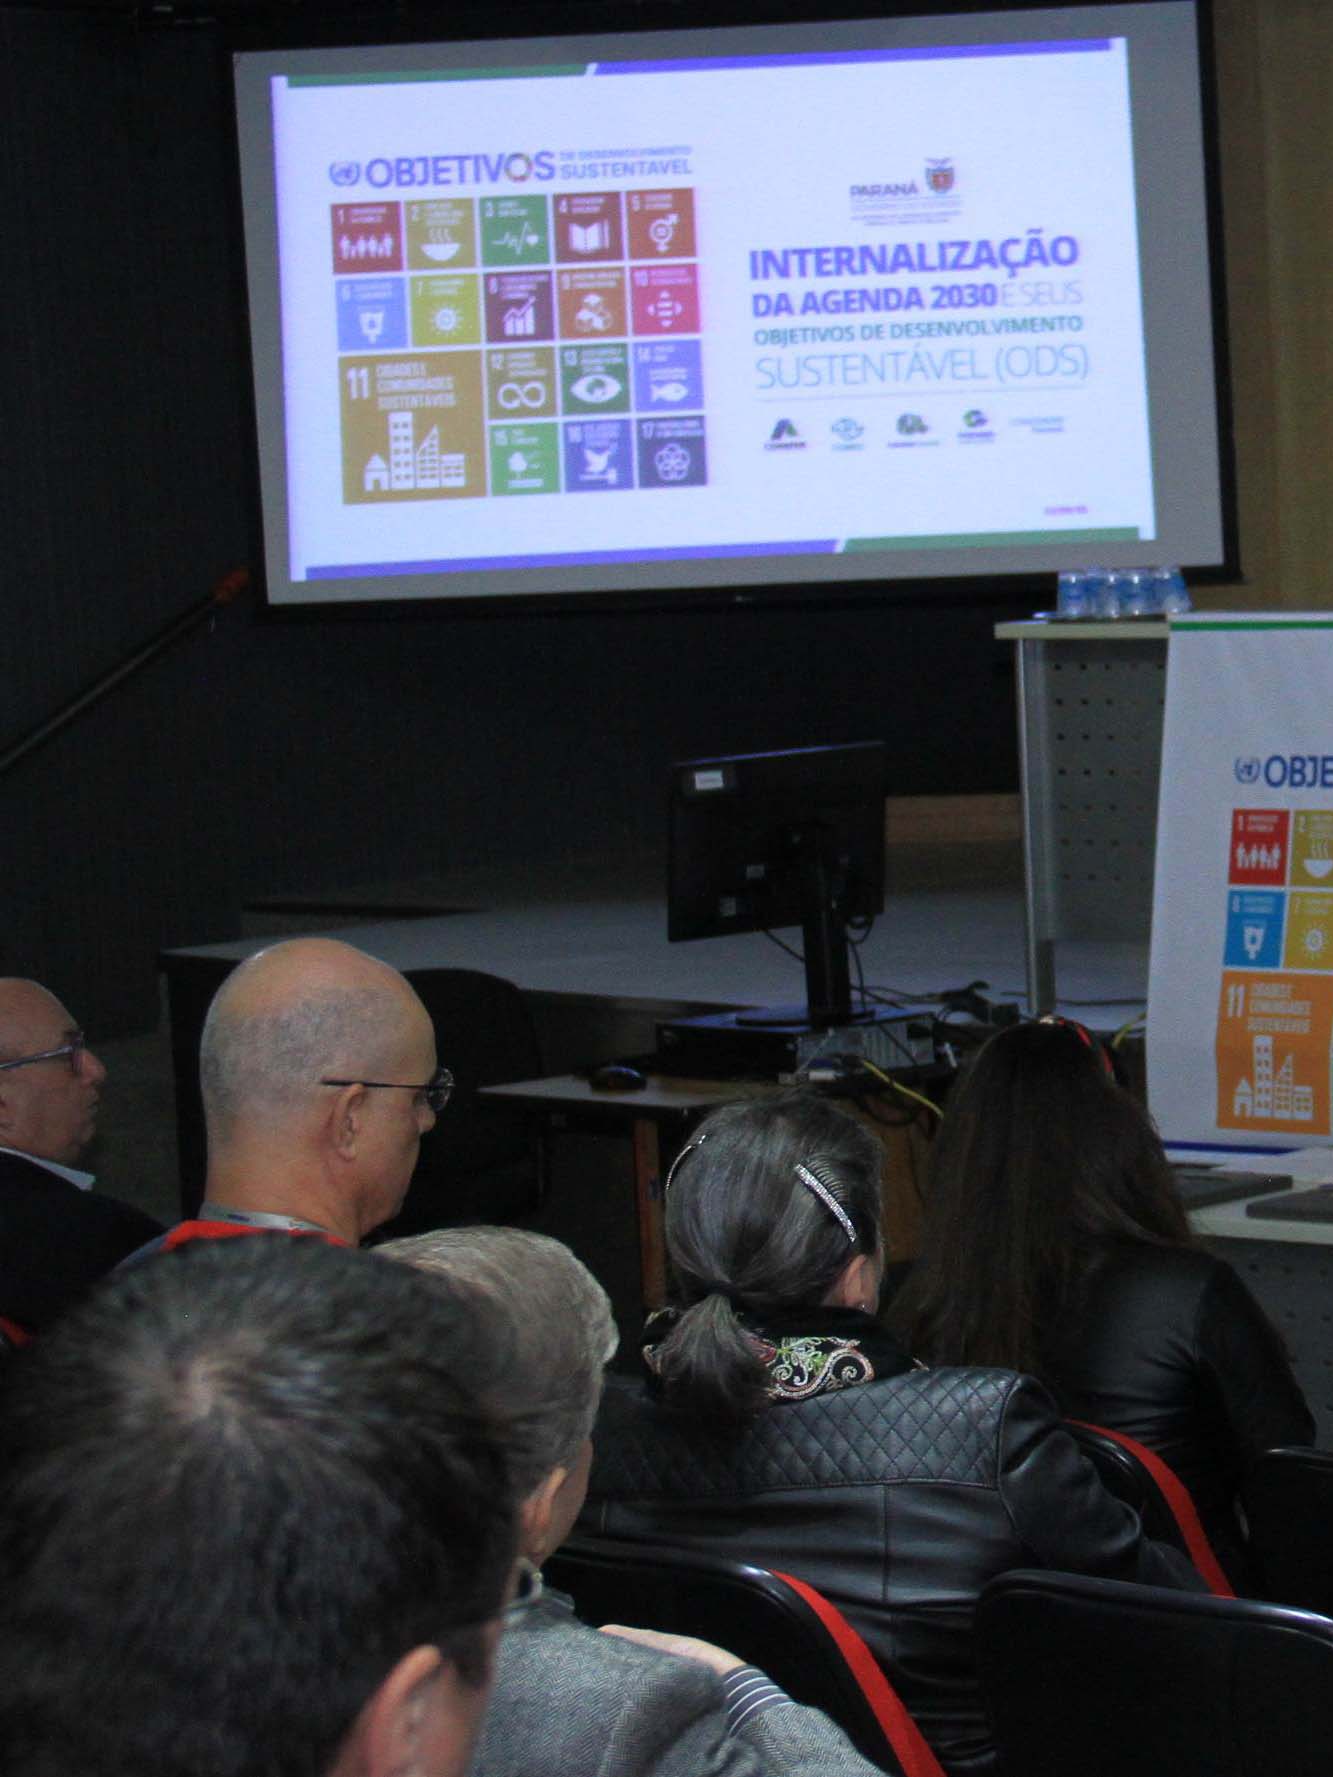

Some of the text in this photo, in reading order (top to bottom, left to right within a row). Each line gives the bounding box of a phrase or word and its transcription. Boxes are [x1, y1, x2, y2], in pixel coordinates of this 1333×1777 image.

[365, 150, 556, 189] OBJETIVOS
[749, 228, 1079, 280] INTERNALIZAÇÃO
[752, 280, 1083, 317] DA AGENDA 2030 E SEUS
[754, 315, 1084, 348] OBJETIVOS DE DESENVOLVIMENTO
[346, 367, 369, 400] 11
[755, 342, 1089, 390] SUSTENTÁVEL (ODS)
[1227, 984, 1246, 1019] 11
